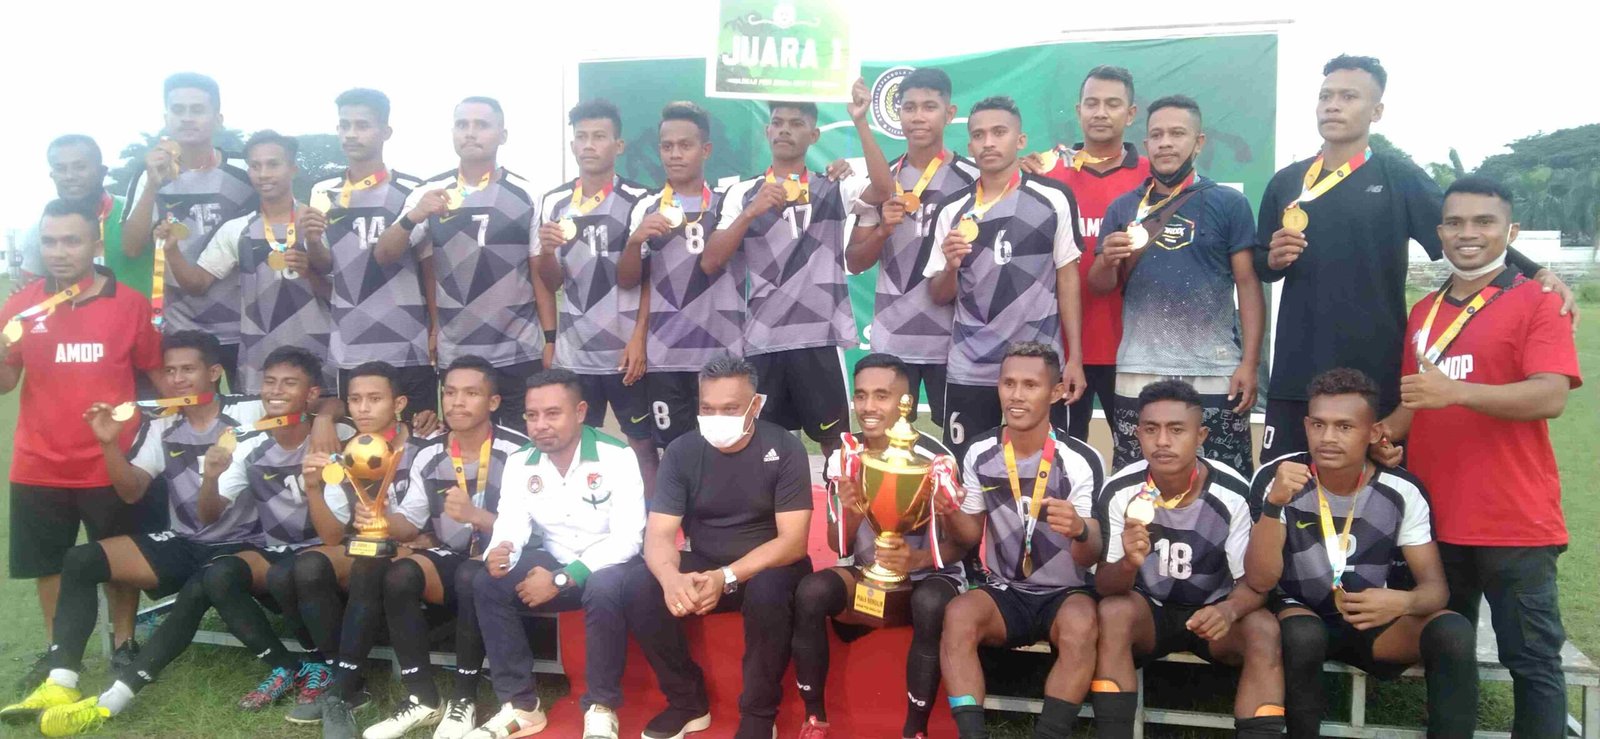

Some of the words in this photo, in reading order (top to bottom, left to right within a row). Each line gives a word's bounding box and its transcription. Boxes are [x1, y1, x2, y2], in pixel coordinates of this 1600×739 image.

[721, 36, 819, 68] JUARA
[189, 203, 221, 235] 15
[352, 216, 385, 250] 14
[472, 214, 489, 247] 7
[782, 203, 812, 239] 17
[583, 225, 609, 257] 11
[685, 223, 704, 254] 8
[994, 229, 1012, 265] 6
[55, 343, 104, 363] AMOP
[1438, 354, 1473, 379] MOP
[653, 401, 671, 430] 8
[950, 411, 965, 445] 6
[1154, 537, 1193, 580] 18
